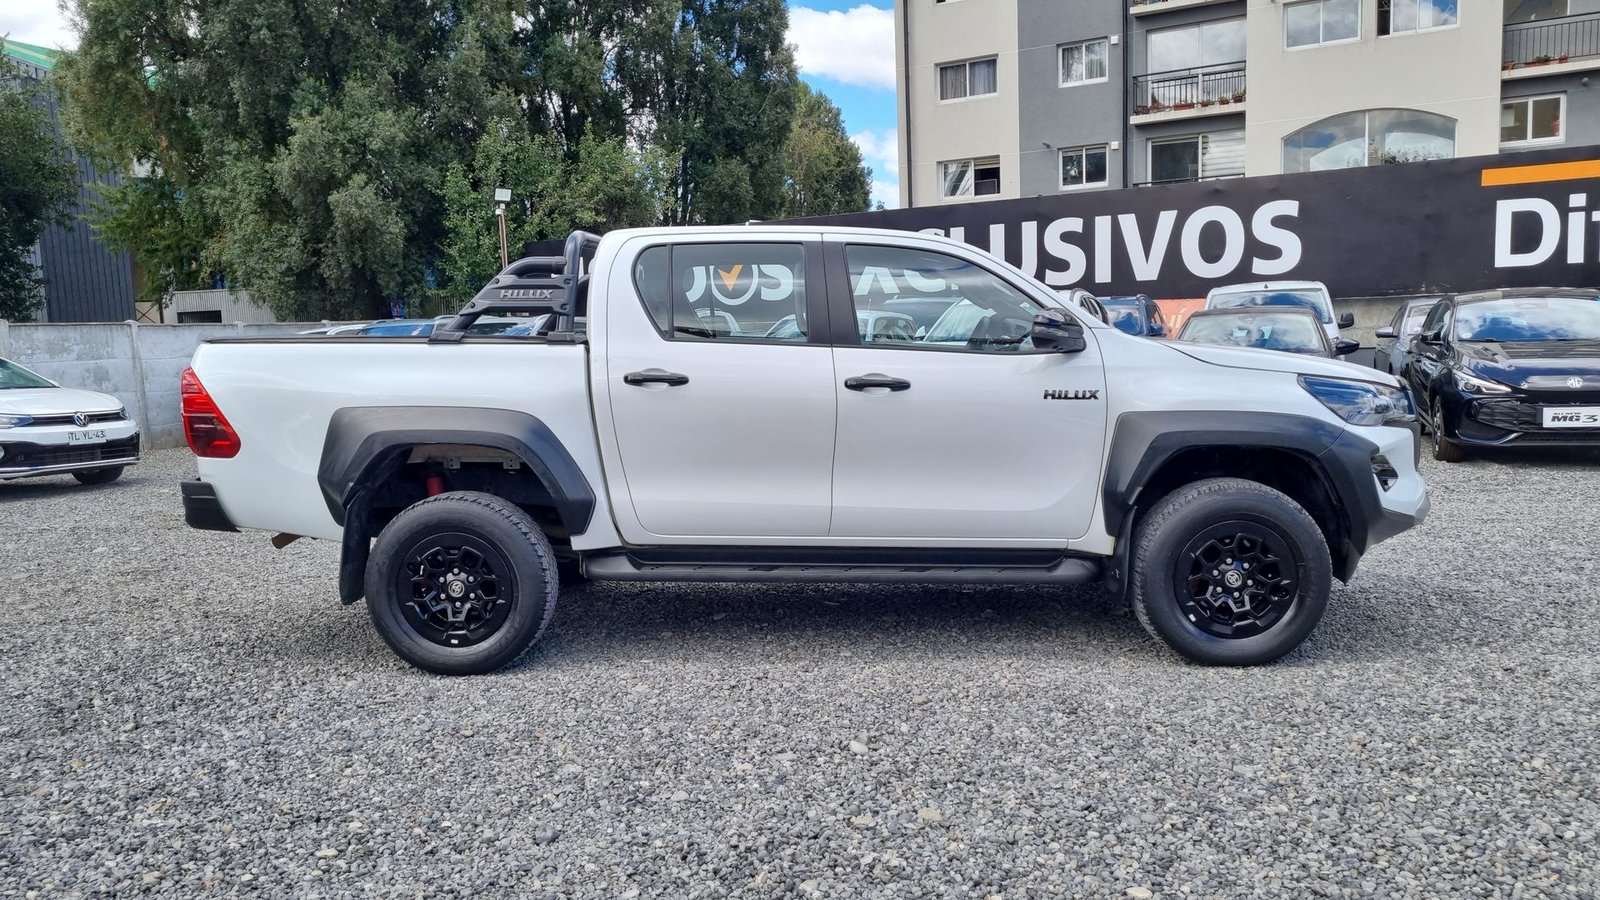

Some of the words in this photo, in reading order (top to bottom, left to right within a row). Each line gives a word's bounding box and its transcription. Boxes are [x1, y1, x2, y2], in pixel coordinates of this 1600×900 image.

[1494, 193, 1600, 268] Di
[500, 289, 554, 299] HILUX
[1043, 389, 1100, 400] HILUX
